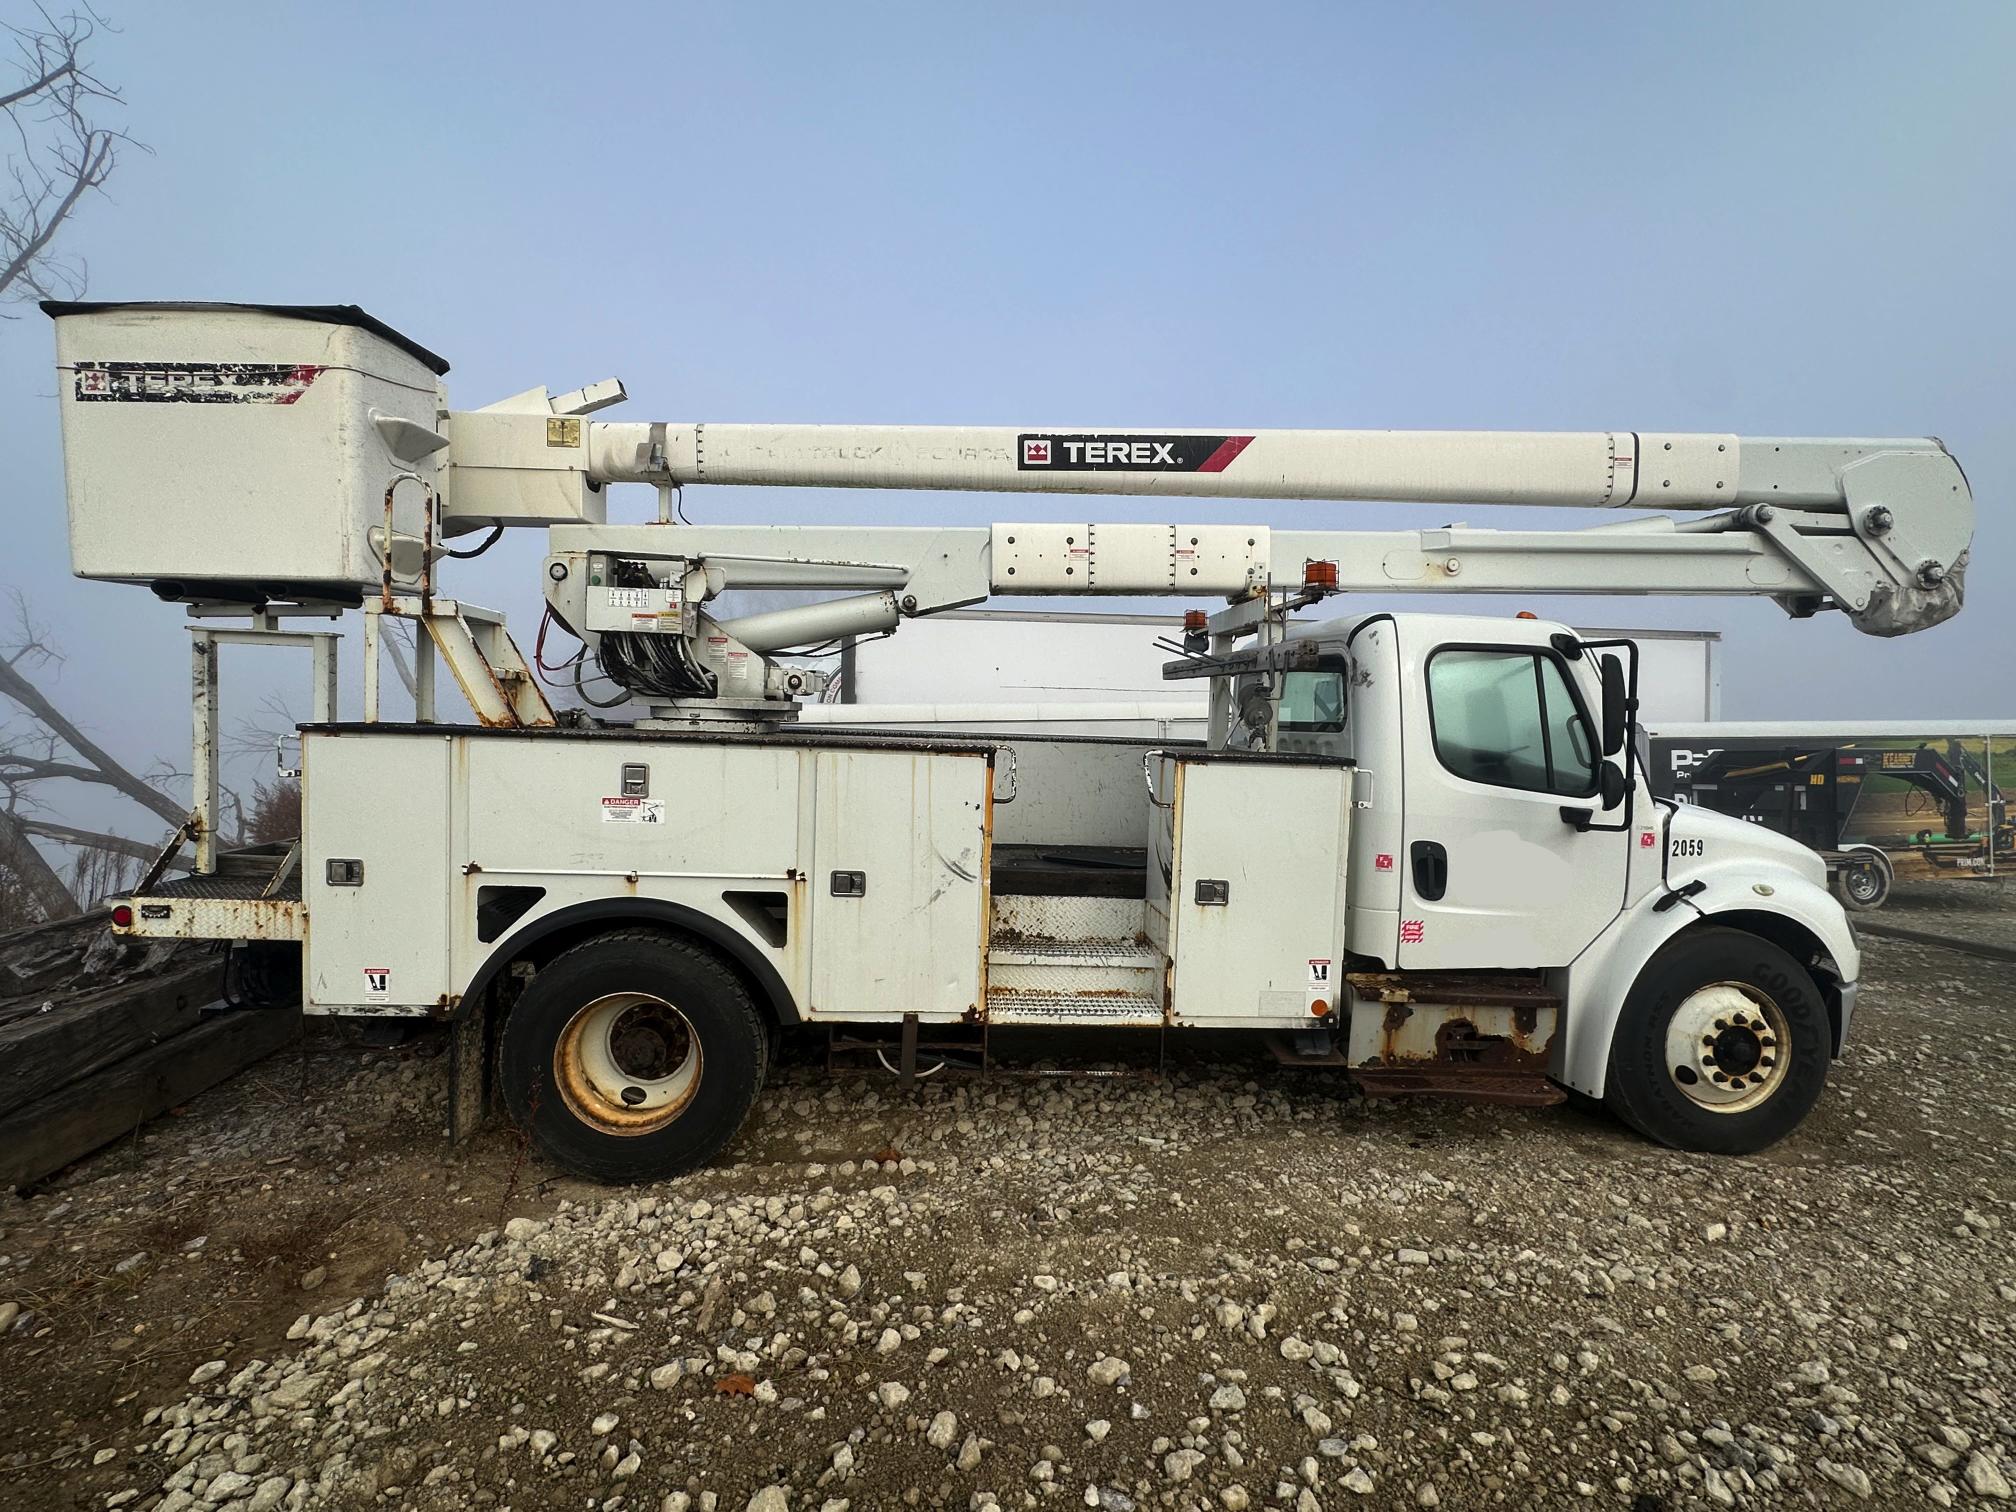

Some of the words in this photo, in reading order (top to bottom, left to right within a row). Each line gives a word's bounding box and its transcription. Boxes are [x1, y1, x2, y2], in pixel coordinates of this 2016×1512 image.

[1062, 441, 1175, 464] TEREX
[1809, 774, 1825, 785] HD
[1672, 839, 1704, 857] 2059
